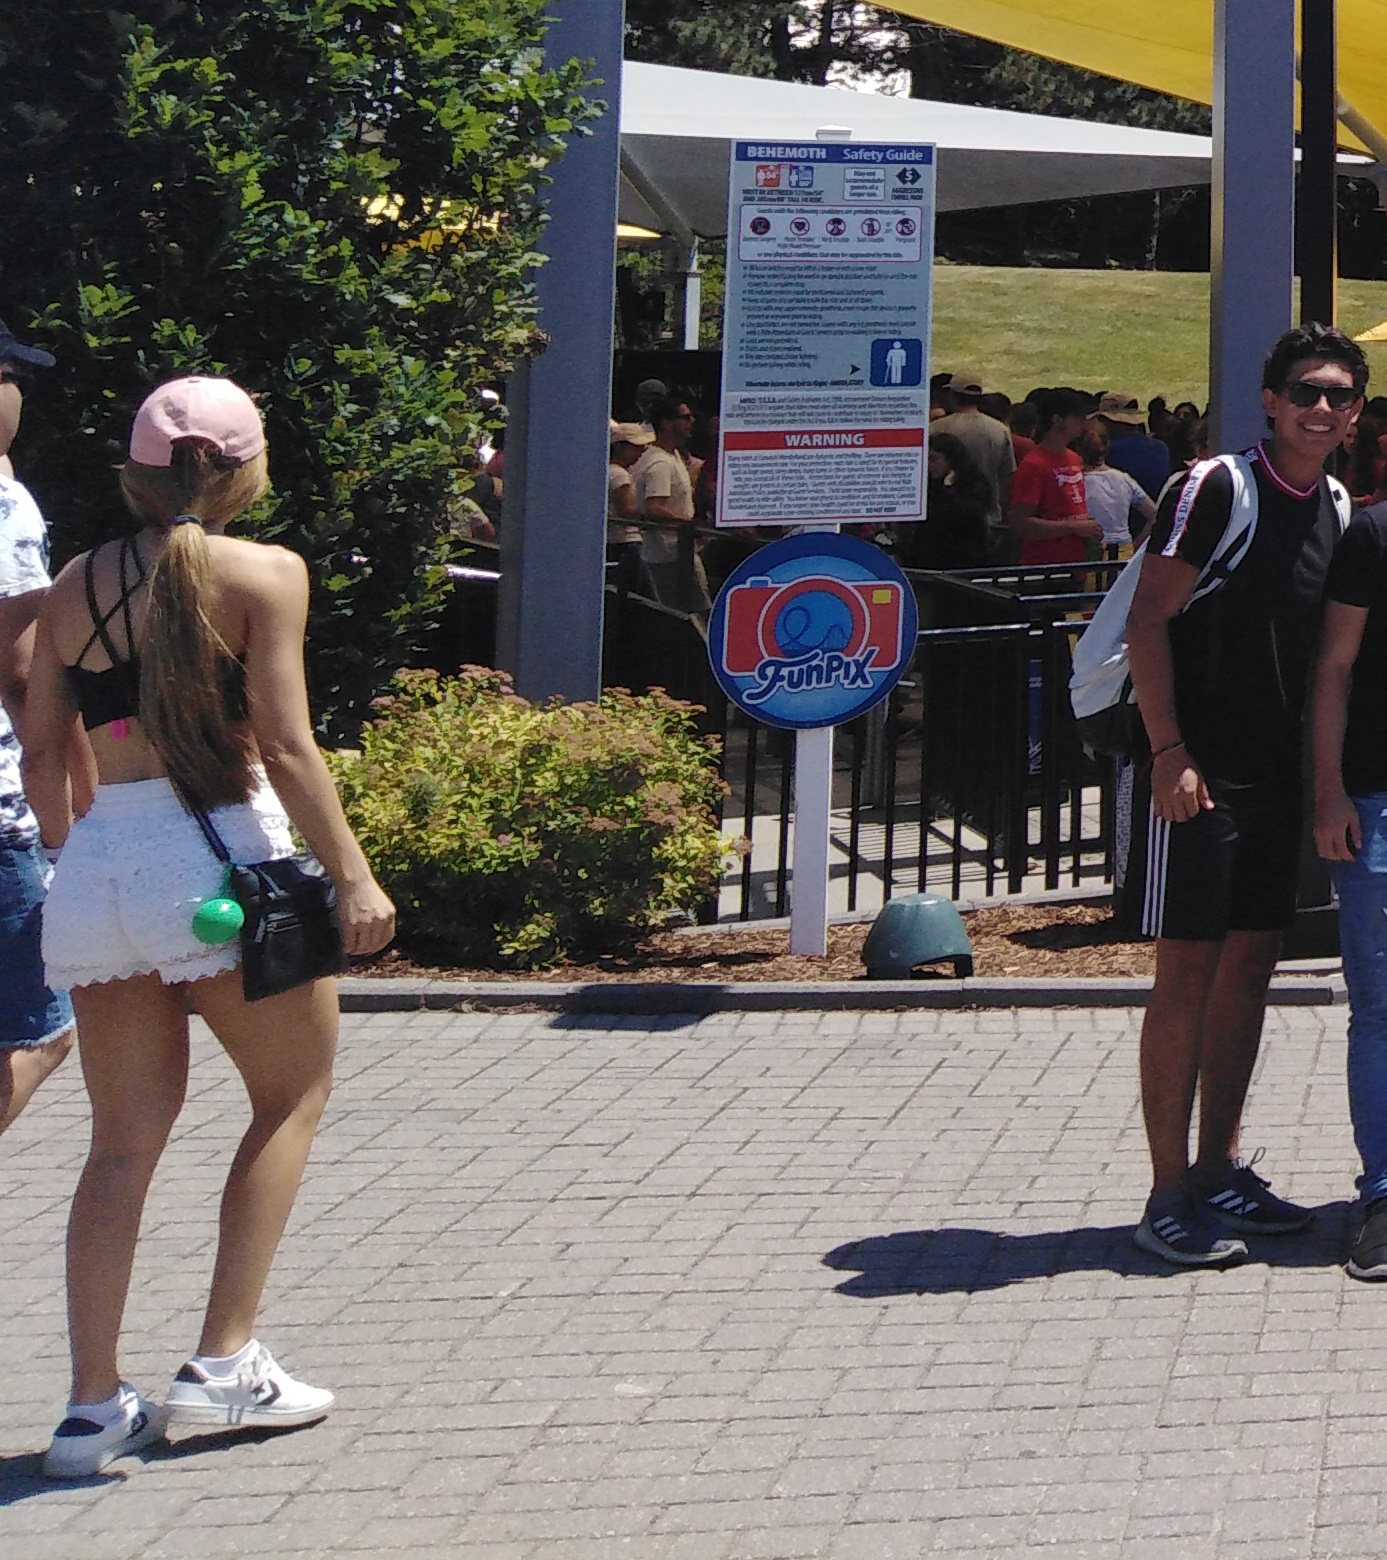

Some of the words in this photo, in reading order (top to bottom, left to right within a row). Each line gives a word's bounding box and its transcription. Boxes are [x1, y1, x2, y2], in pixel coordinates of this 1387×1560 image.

[746, 145, 827, 160] BEHEMOTH
[843, 147, 883, 163] Safety
[886, 148, 923, 161] Guide
[785, 432, 865, 447] WARNING
